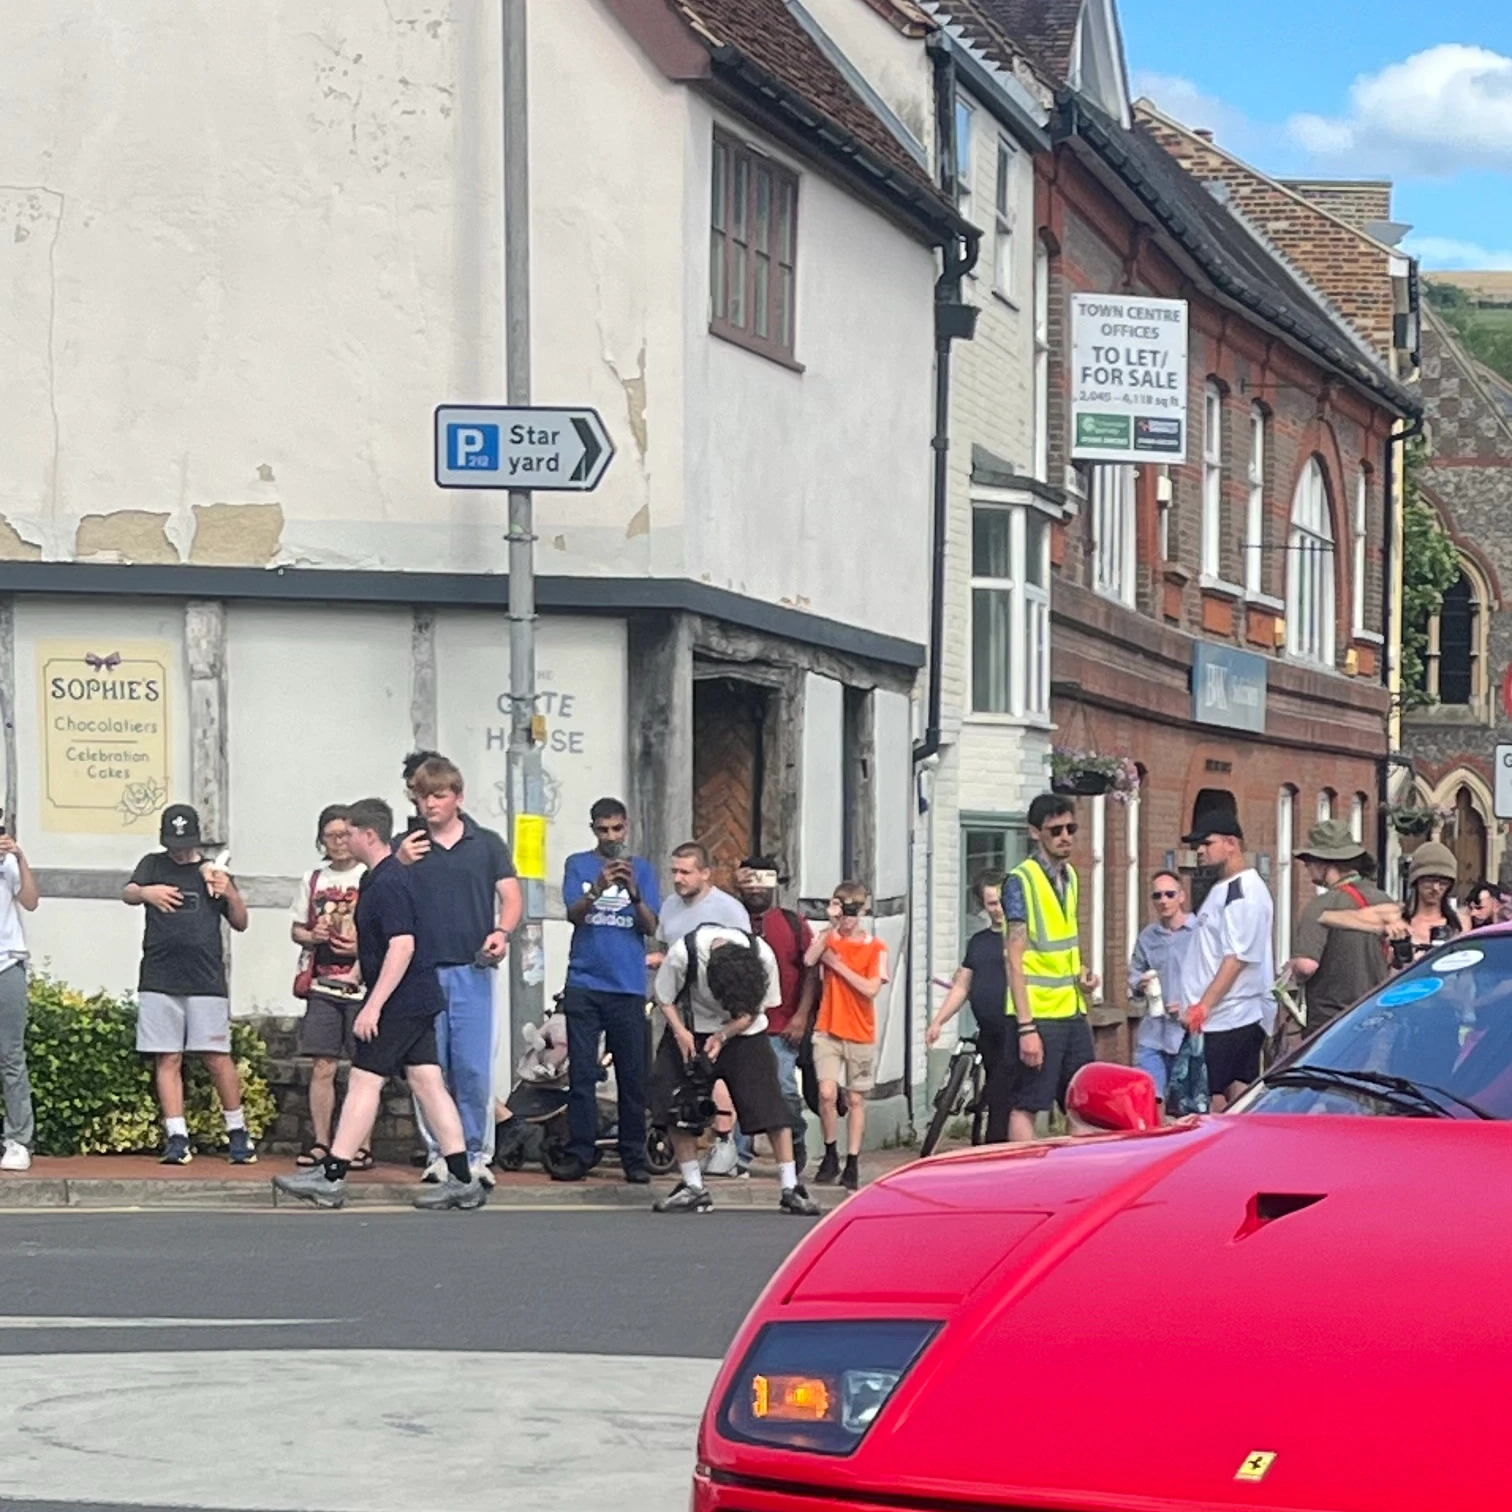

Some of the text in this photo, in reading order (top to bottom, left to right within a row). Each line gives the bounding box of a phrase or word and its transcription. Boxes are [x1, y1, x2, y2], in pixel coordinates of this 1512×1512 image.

[1078, 303, 1180, 323] TOWN CENTRE
[1101, 323, 1160, 340] OFFICES
[1092, 346, 1169, 369] TO LET/
[1081, 366, 1178, 390] FOR SALE
[1155, 396, 1169, 409] sq
[456, 424, 560, 467] P Star
[508, 452, 560, 475] yard
[51, 677, 160, 702] SOPHIE'S
[54, 716, 158, 734] Chocolatiers
[65, 747, 150, 763] Celebration
[87, 765, 131, 780] Cakes
[585, 911, 634, 928] adidas
